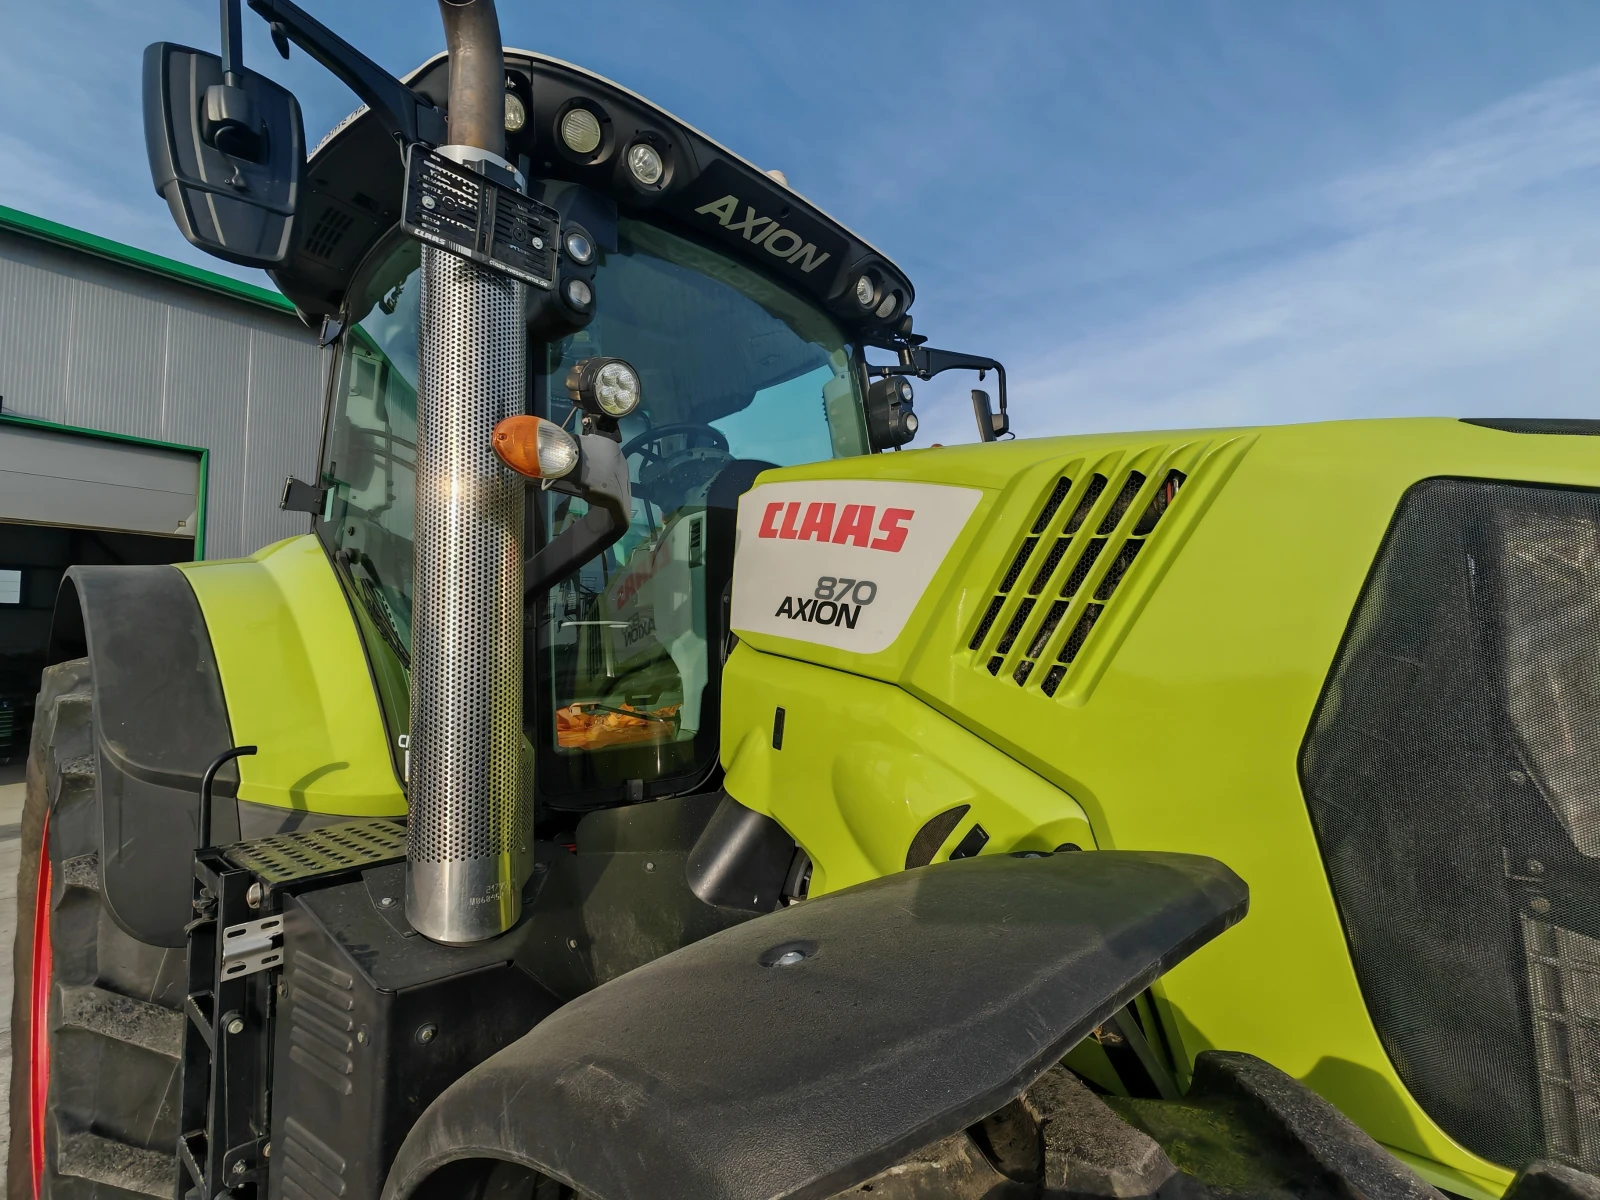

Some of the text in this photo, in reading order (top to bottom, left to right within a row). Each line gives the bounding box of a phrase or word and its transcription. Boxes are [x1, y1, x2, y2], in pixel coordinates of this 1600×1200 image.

[413, 228, 446, 246] CLAAS
[694, 194, 831, 273] AXION
[758, 502, 915, 553] CLAAS
[814, 576, 878, 606] 870
[775, 596, 862, 629] AXION
